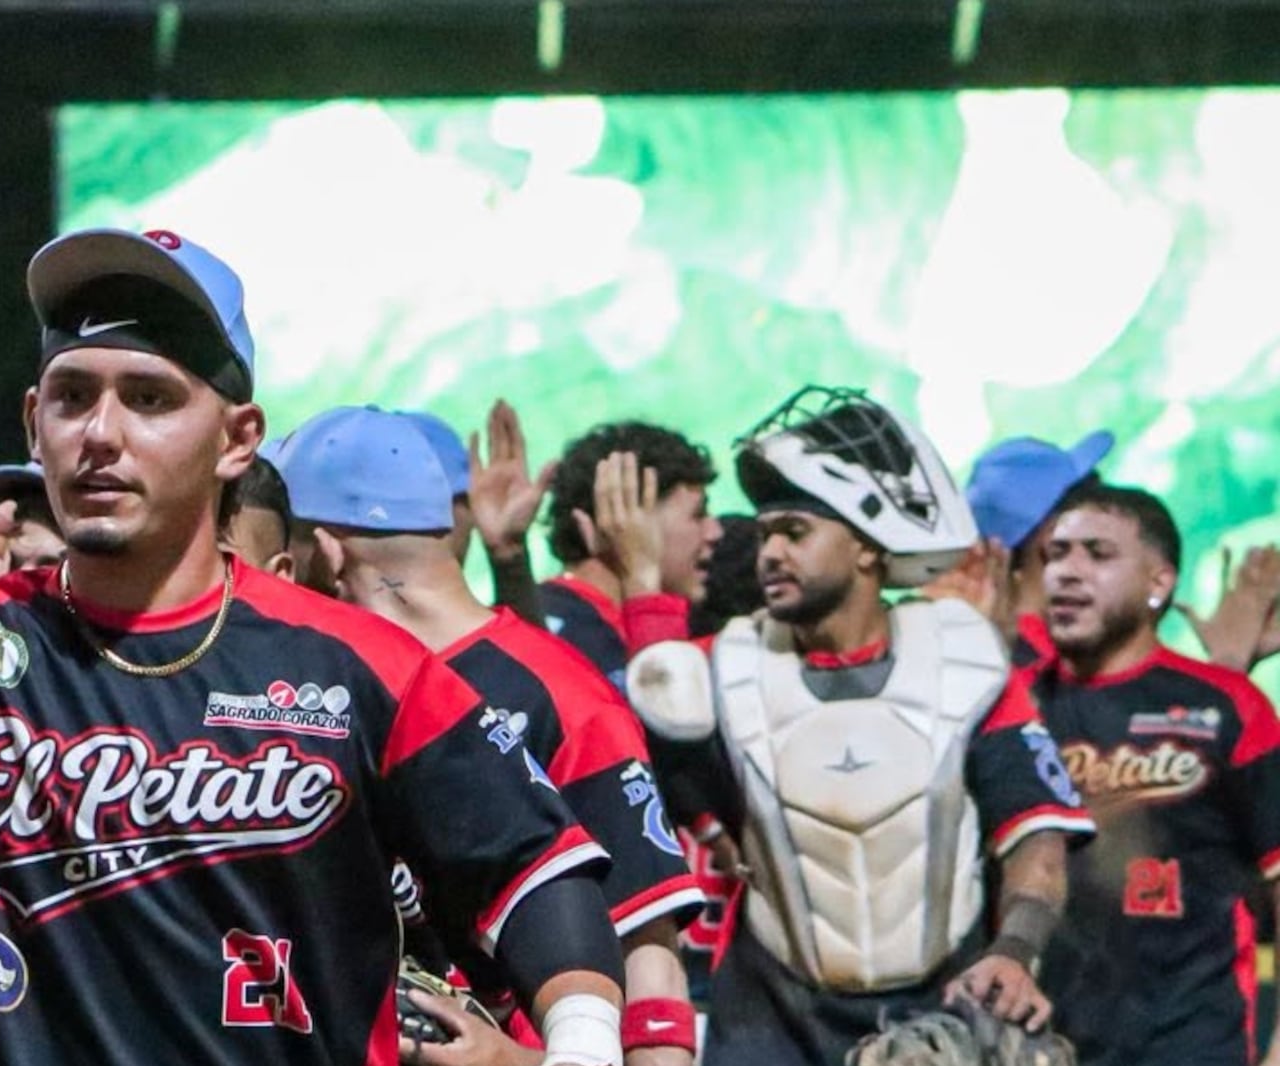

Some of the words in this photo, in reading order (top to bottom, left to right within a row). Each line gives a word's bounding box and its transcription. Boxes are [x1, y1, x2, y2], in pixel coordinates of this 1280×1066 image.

[207, 704, 280, 723] SAGRADO
[61, 733, 334, 840] Petate
[62, 846, 150, 883] CITY
[1123, 858, 1184, 918] 21
[222, 928, 313, 1034] 21
